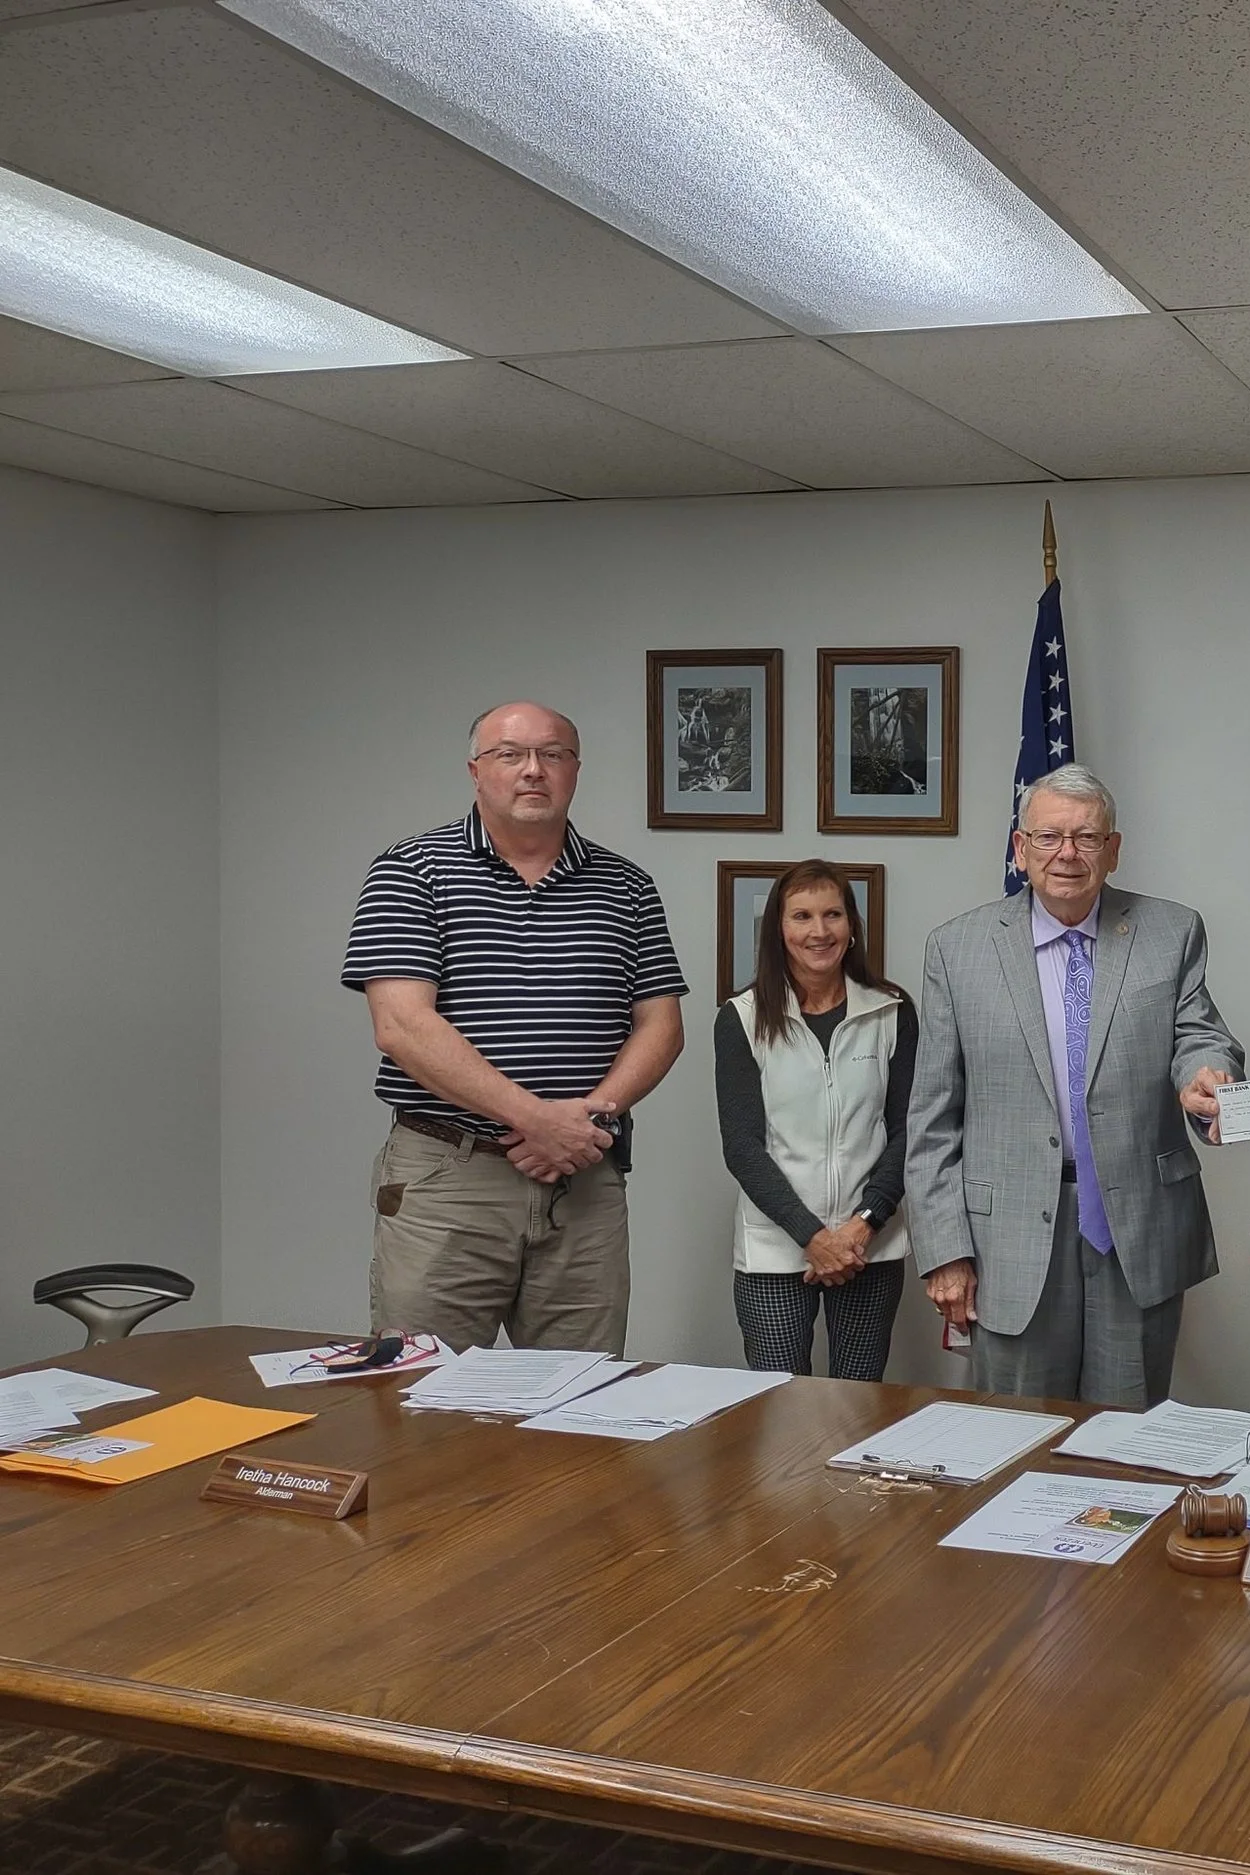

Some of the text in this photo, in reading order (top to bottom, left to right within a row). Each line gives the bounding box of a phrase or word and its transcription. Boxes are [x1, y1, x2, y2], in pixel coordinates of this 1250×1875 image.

[1219, 1086, 1234, 1094] FIRST
[235, 1466, 331, 1493] Iretha Hancock
